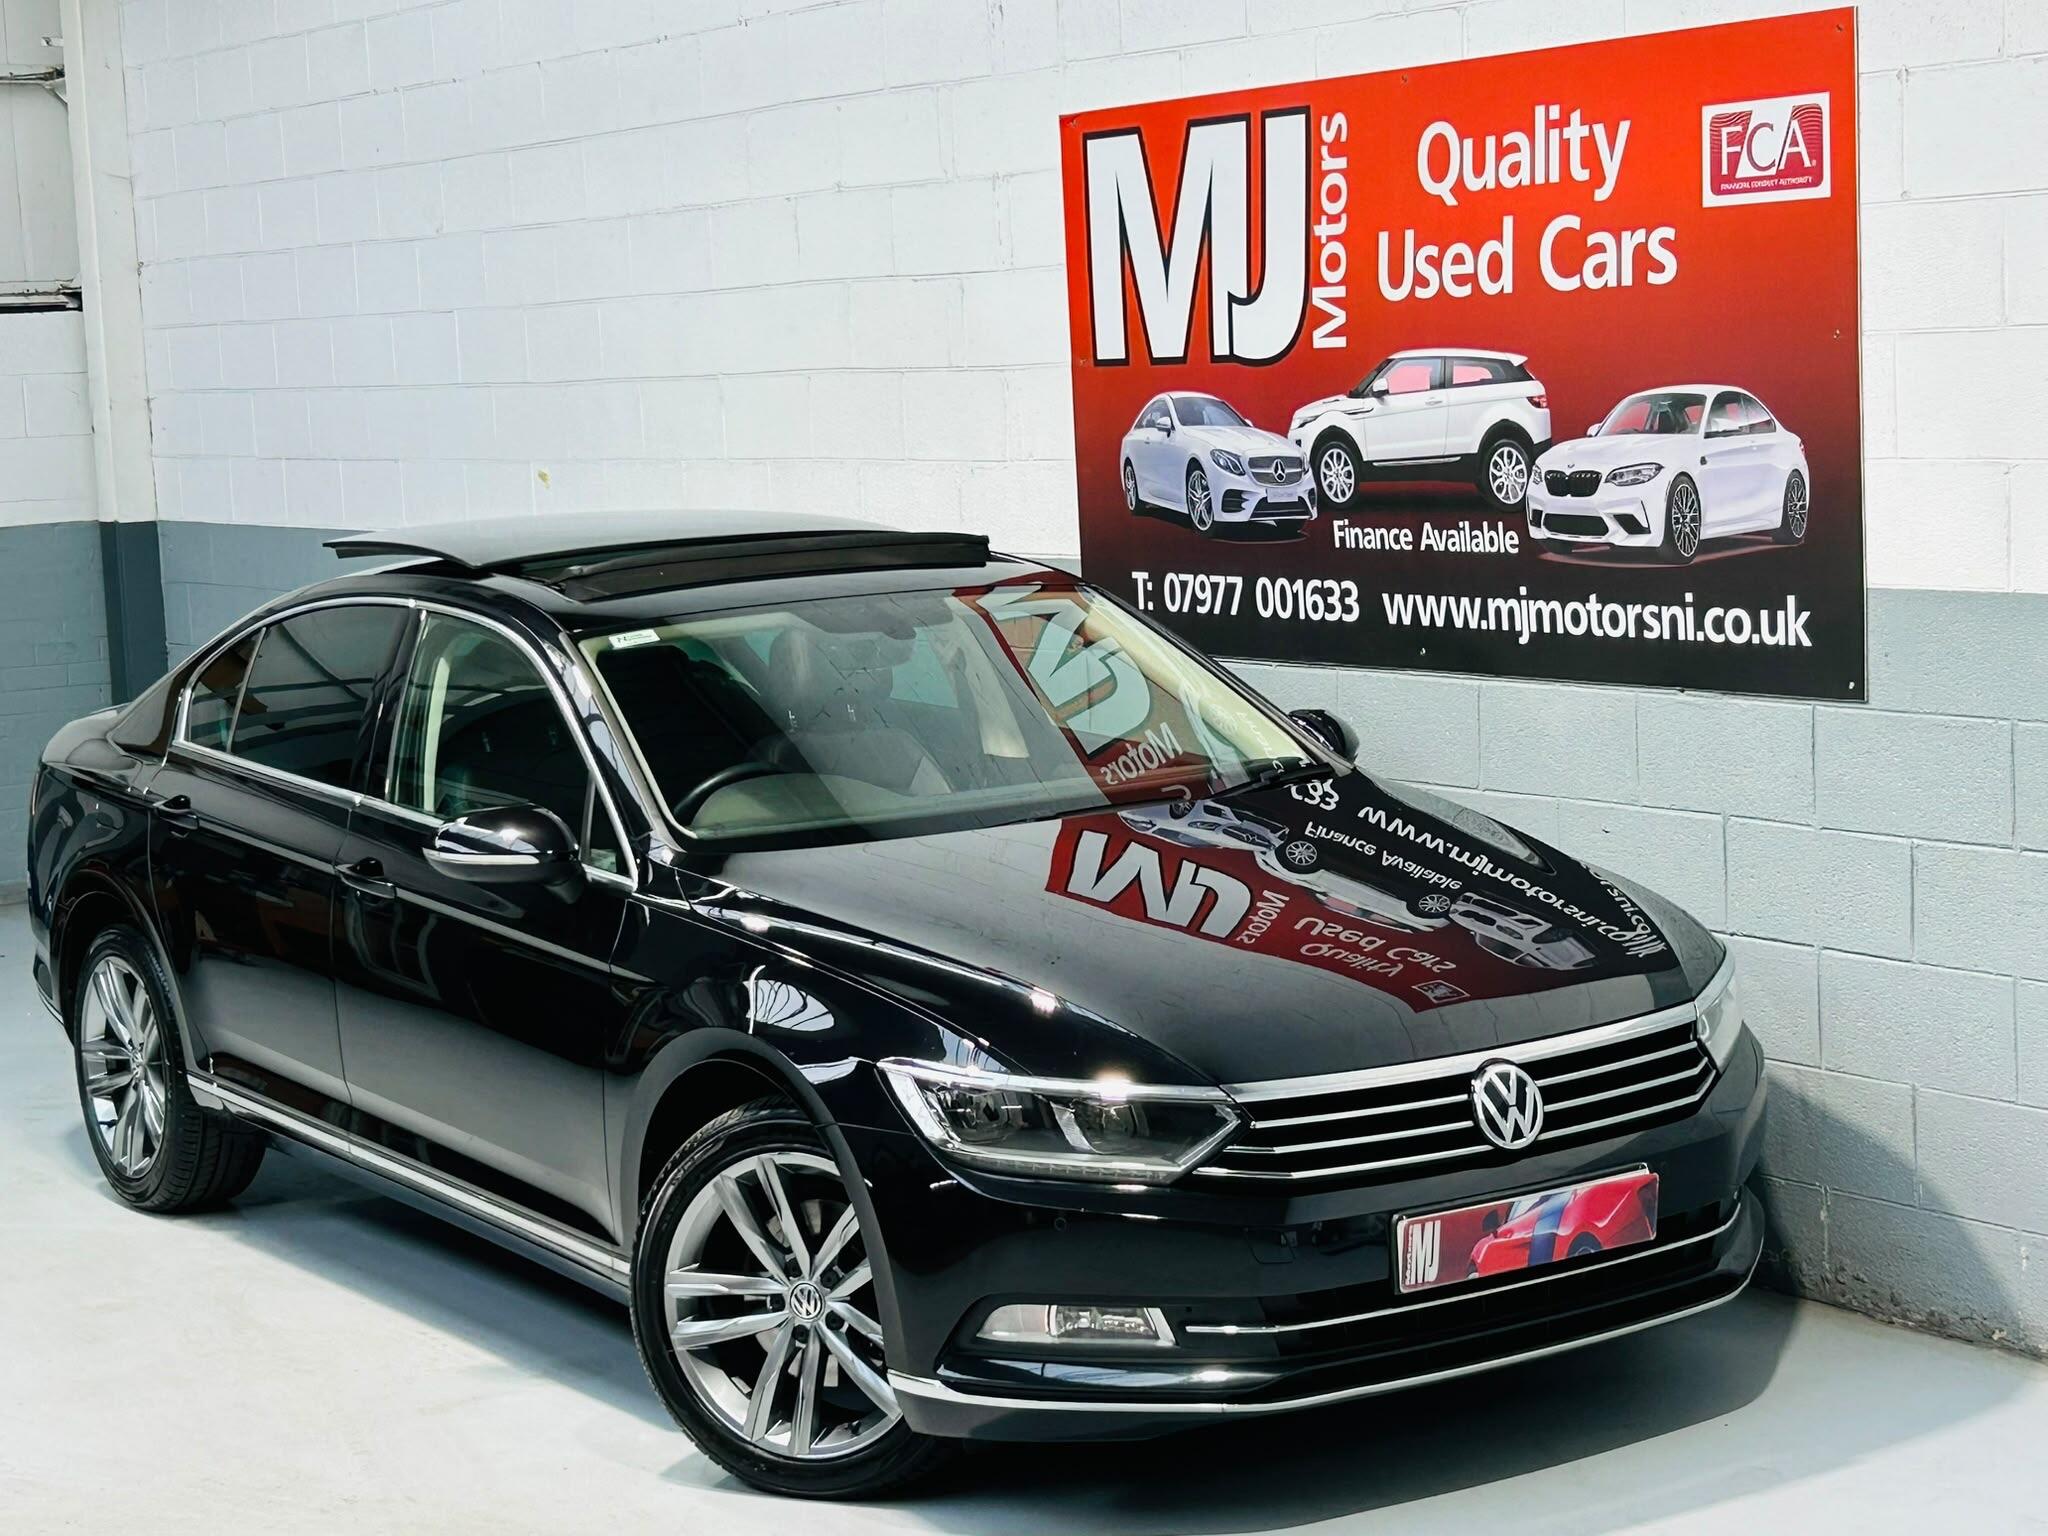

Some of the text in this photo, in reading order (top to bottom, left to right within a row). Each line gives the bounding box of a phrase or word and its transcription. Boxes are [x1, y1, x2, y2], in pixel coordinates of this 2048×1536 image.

[1417, 104, 1631, 206] Quality
[1721, 119, 1813, 176] FCA
[1084, 107, 1310, 365] MJ
[1311, 111, 1348, 349] Motors
[1378, 214, 1678, 302] Used Cars
[1333, 518, 1520, 554] Finance Available
[1132, 571, 1360, 622] T: 07977 001633
[1381, 586, 1813, 648] www.mjmotorsni.co.uk
[1410, 1219, 1442, 1285] MJ
